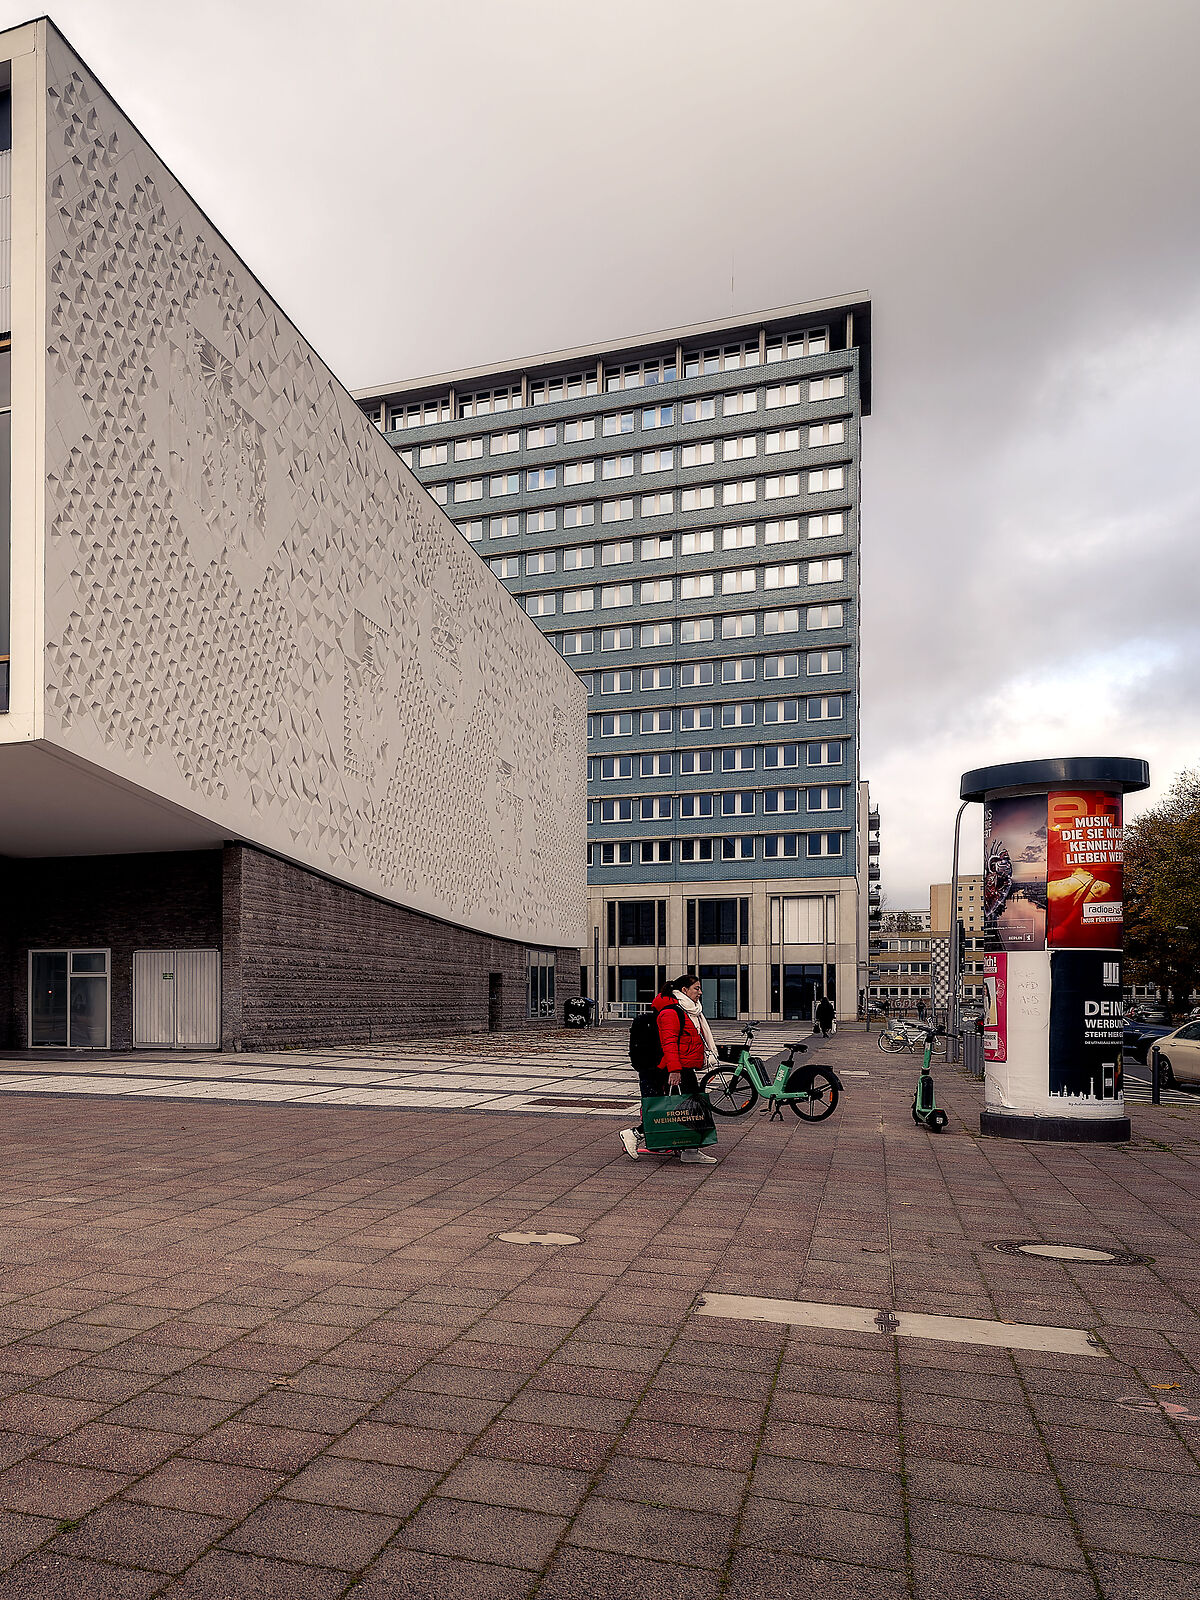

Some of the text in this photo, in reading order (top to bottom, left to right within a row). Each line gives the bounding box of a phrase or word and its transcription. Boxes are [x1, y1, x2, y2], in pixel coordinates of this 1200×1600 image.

[1075, 816, 1113, 828] MUSIK,
[1061, 829, 1084, 841] DIE
[1086, 828, 1105, 839] SIE
[1069, 840, 1114, 852] KENNEN
[1066, 852, 1108, 864] LIEBEN
[653, 1114, 705, 1124] WEIHNACHTEN
[666, 1109, 690, 1117] FROHE
